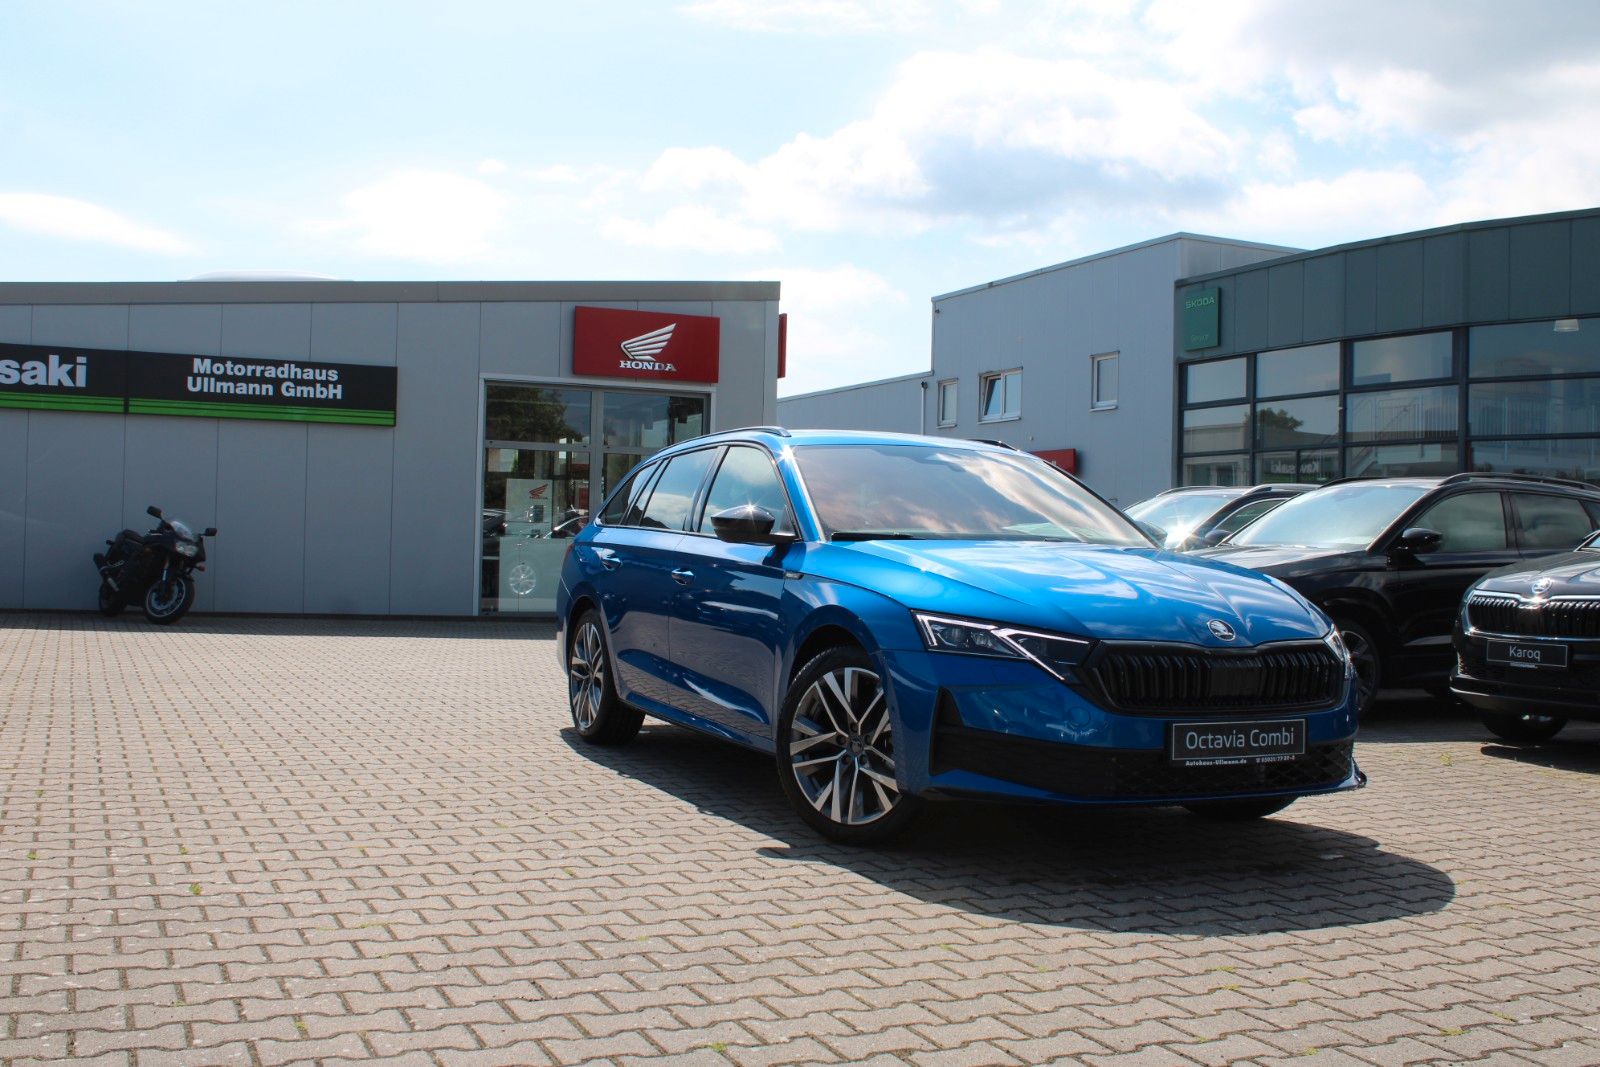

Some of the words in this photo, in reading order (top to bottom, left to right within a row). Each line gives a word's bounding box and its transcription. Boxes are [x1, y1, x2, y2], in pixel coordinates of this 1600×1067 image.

[0, 354, 87, 388] saki
[192, 358, 339, 381] Motorradhaus
[619, 360, 677, 372] HONDA
[187, 376, 274, 397] Ullmann
[280, 381, 343, 400] GmbH
[1509, 645, 1541, 662] Karoq
[1186, 729, 1245, 749] Octavia
[1250, 727, 1294, 747] Combi
